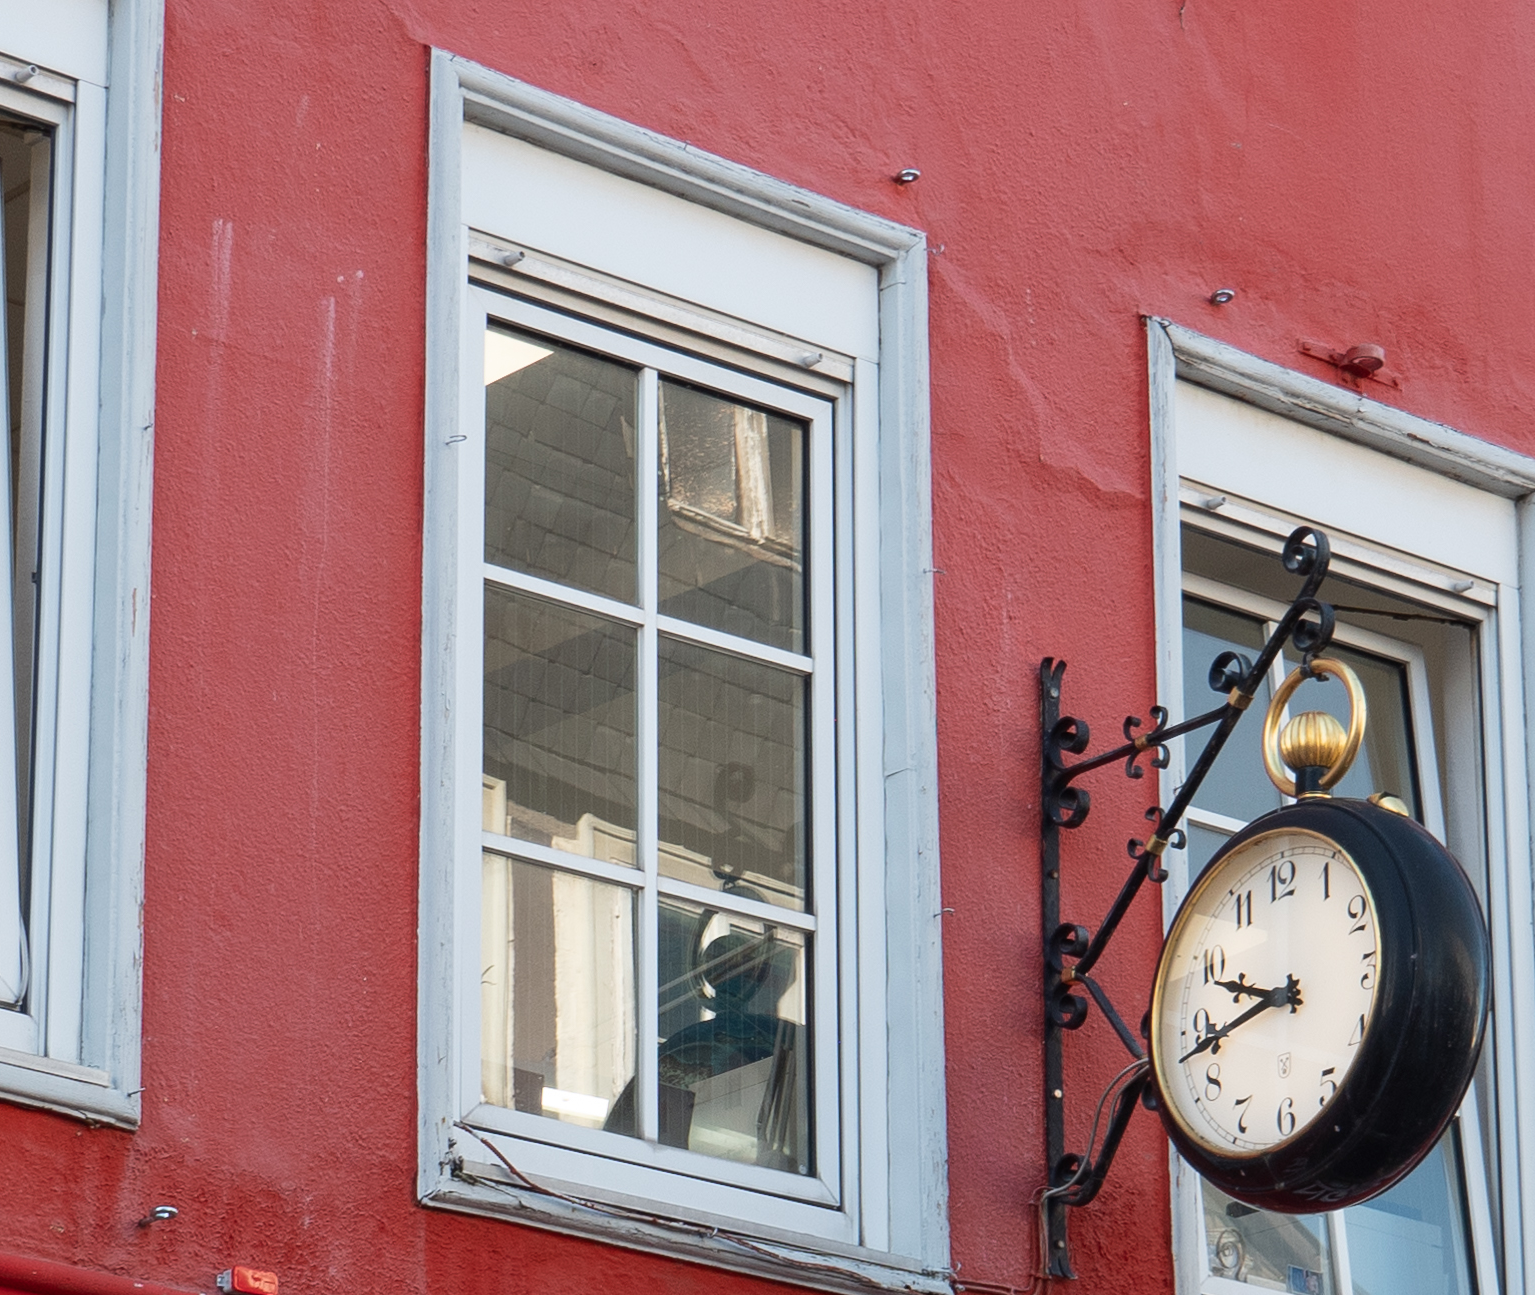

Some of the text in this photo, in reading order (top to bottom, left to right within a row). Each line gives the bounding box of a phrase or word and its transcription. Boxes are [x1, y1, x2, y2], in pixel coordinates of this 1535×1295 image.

[1266, 859, 1297, 904] 12
[1318, 861, 1331, 902] 1
[1231, 889, 1254, 932] 11
[1347, 894, 1369, 936] 2
[1198, 944, 1226, 987] 10
[1204, 1062, 1222, 1102] 8
[1232, 1094, 1254, 1134] 7
[1276, 1096, 1296, 1137] 6
